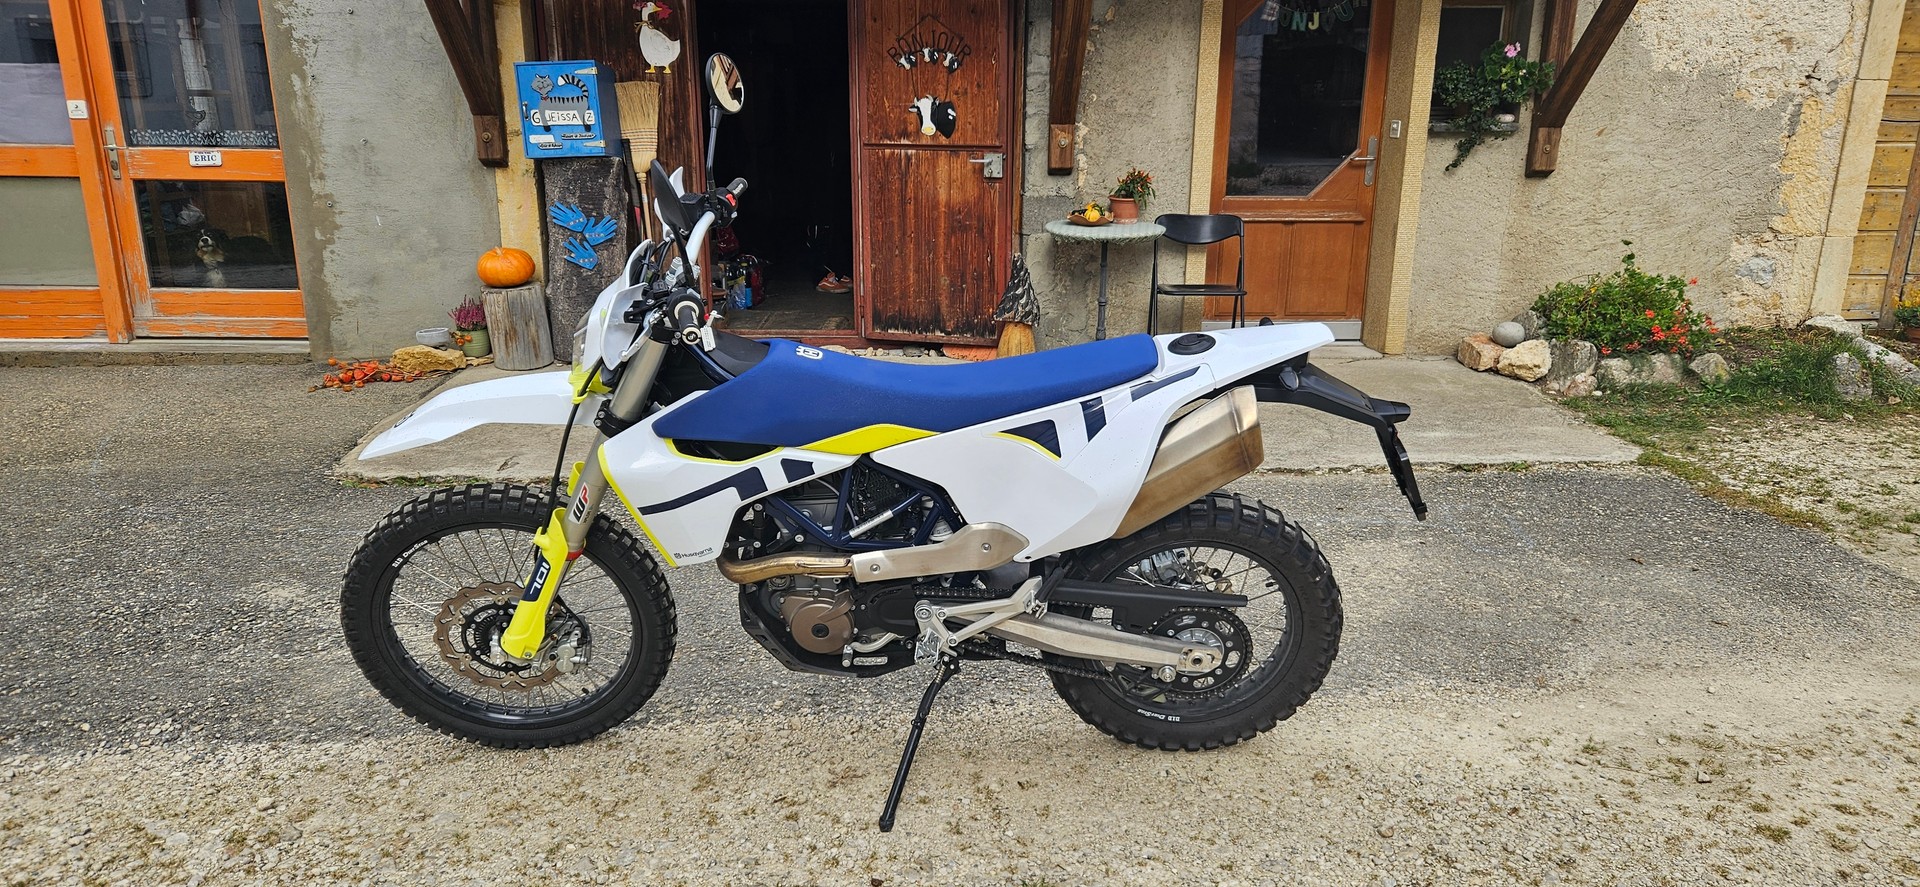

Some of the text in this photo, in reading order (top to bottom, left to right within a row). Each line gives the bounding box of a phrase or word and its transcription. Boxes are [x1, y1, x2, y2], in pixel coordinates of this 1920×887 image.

[573, 479, 589, 523] WP
[681, 546, 713, 557] Husqvarna
[529, 561, 550, 595] 701
